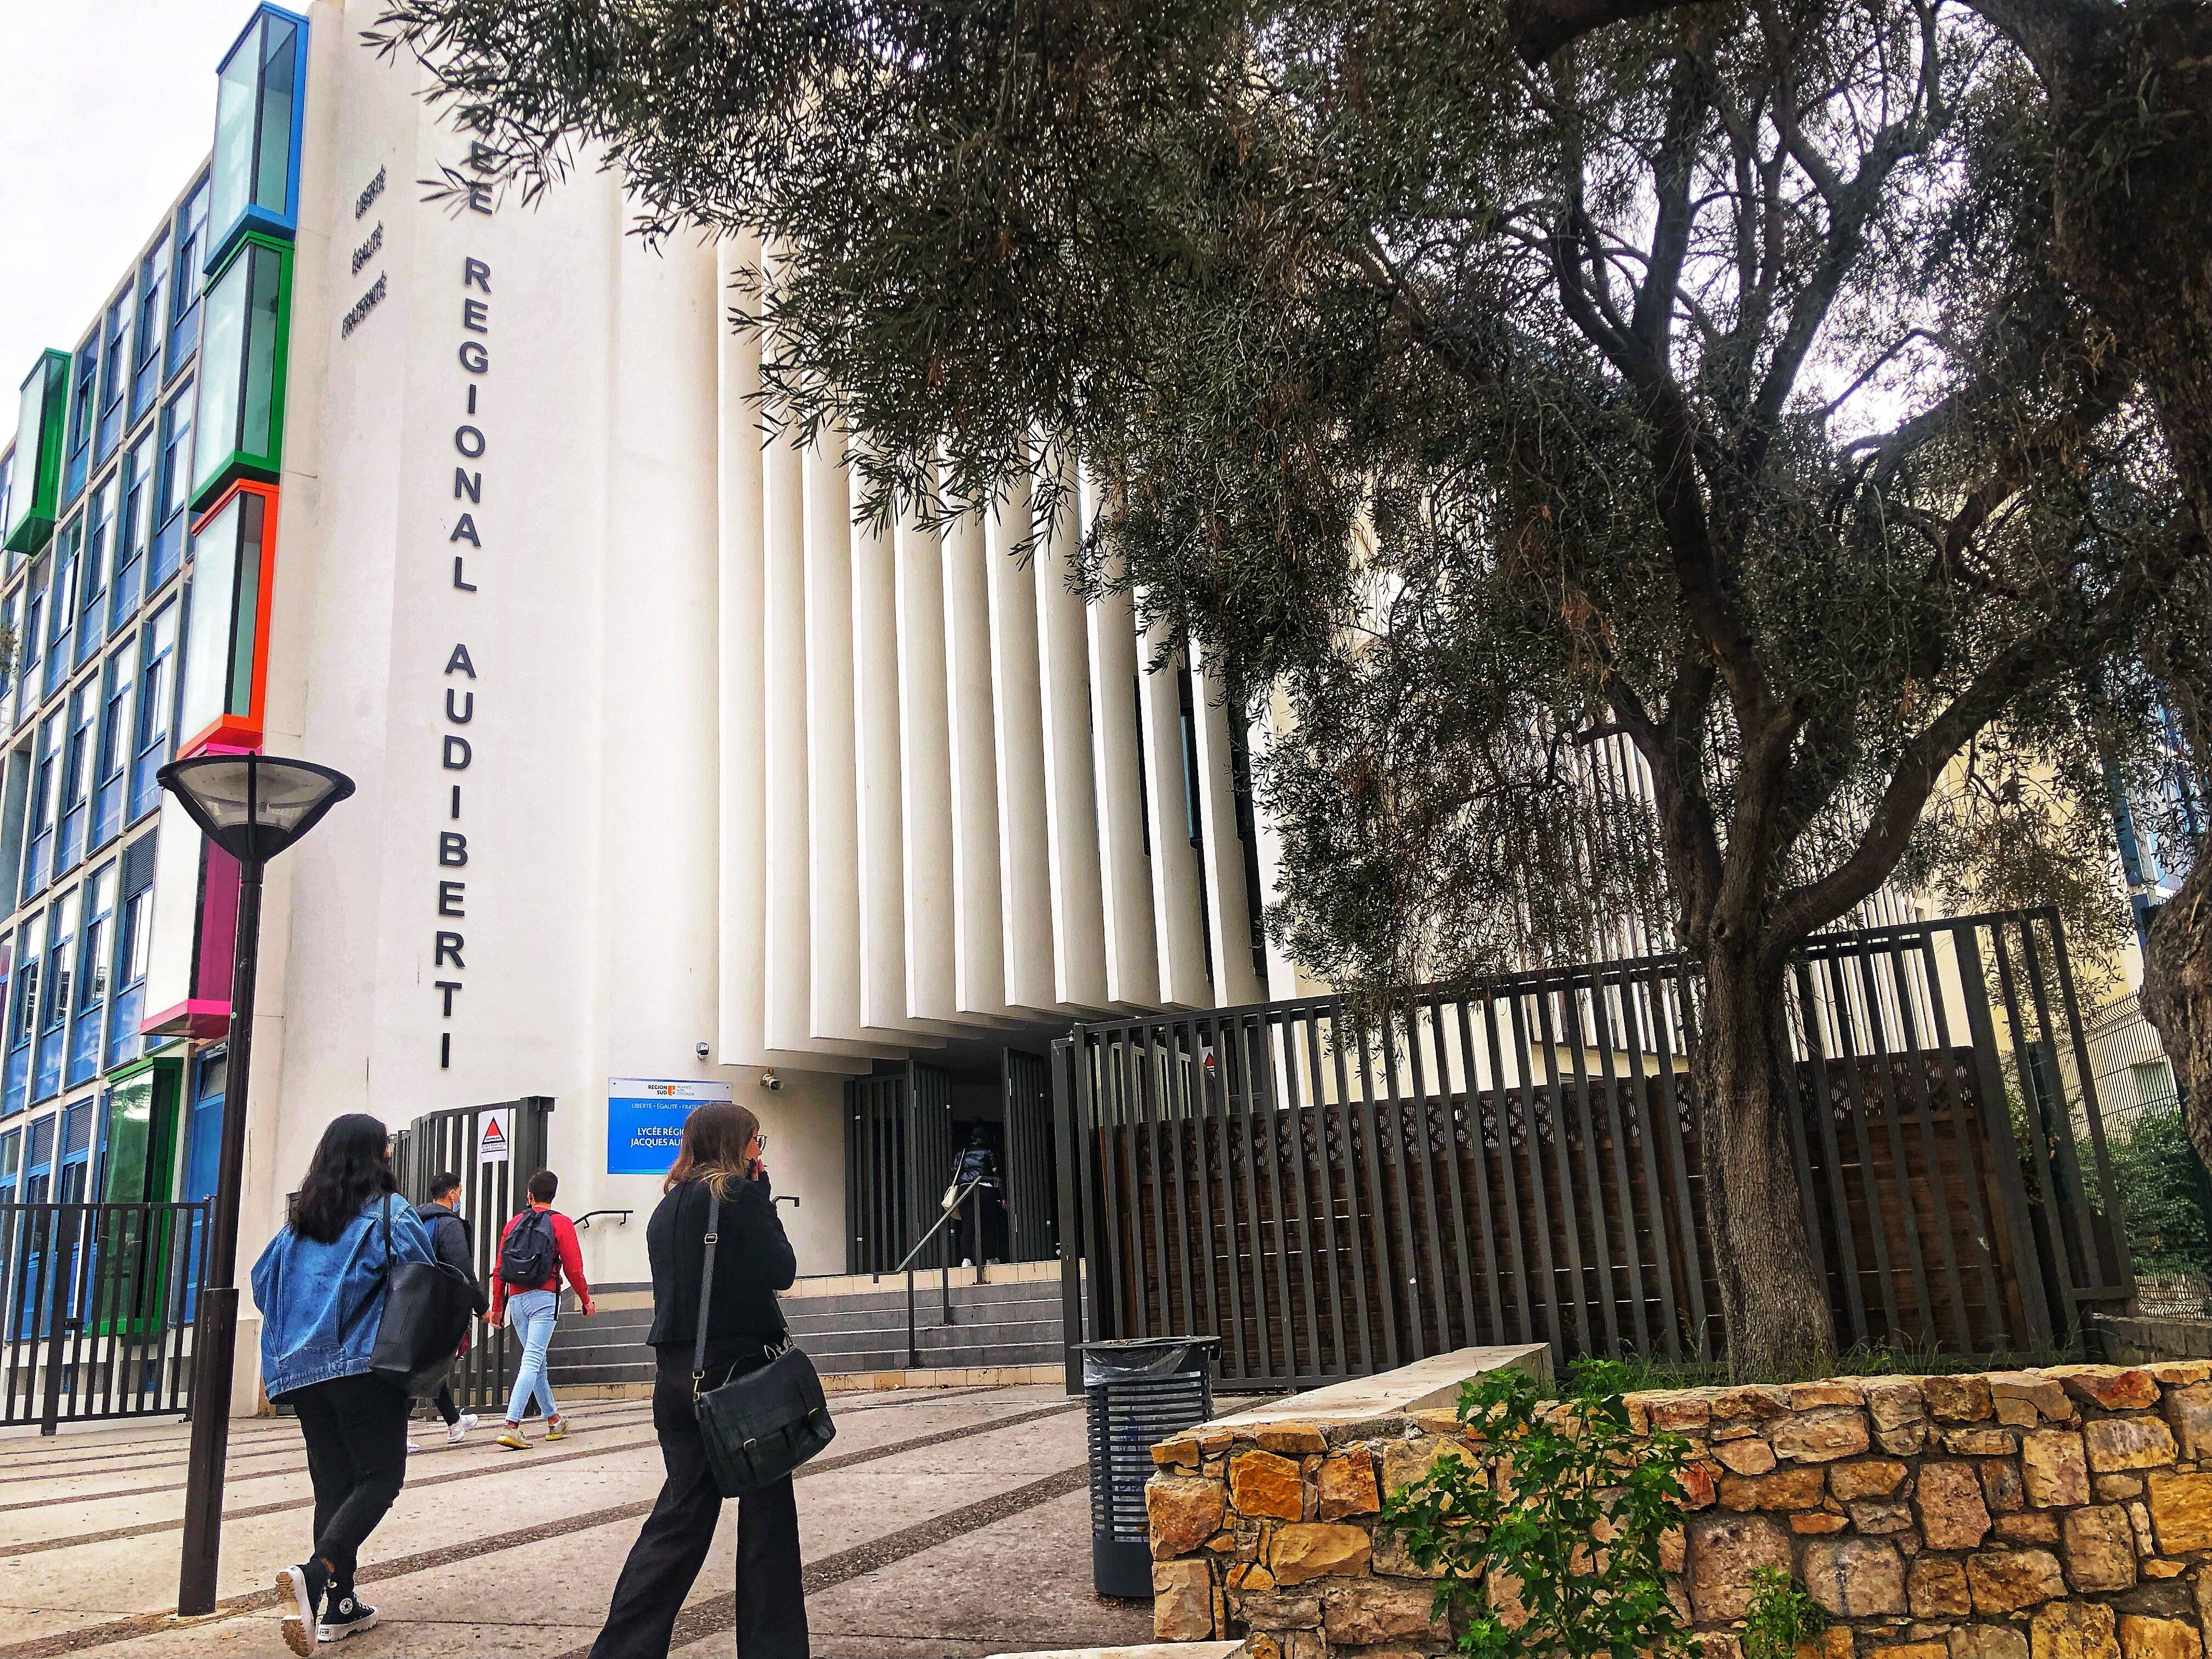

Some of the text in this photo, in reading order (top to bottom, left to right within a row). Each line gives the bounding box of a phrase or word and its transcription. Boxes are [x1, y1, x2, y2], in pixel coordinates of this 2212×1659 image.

[451, 257, 491, 592] REGIONAL
[435, 643, 477, 1069] AUDIBERTI
[630, 1138, 668, 1148] JACQUES
[637, 1126, 685, 1136] LYCÉE RÉGI
